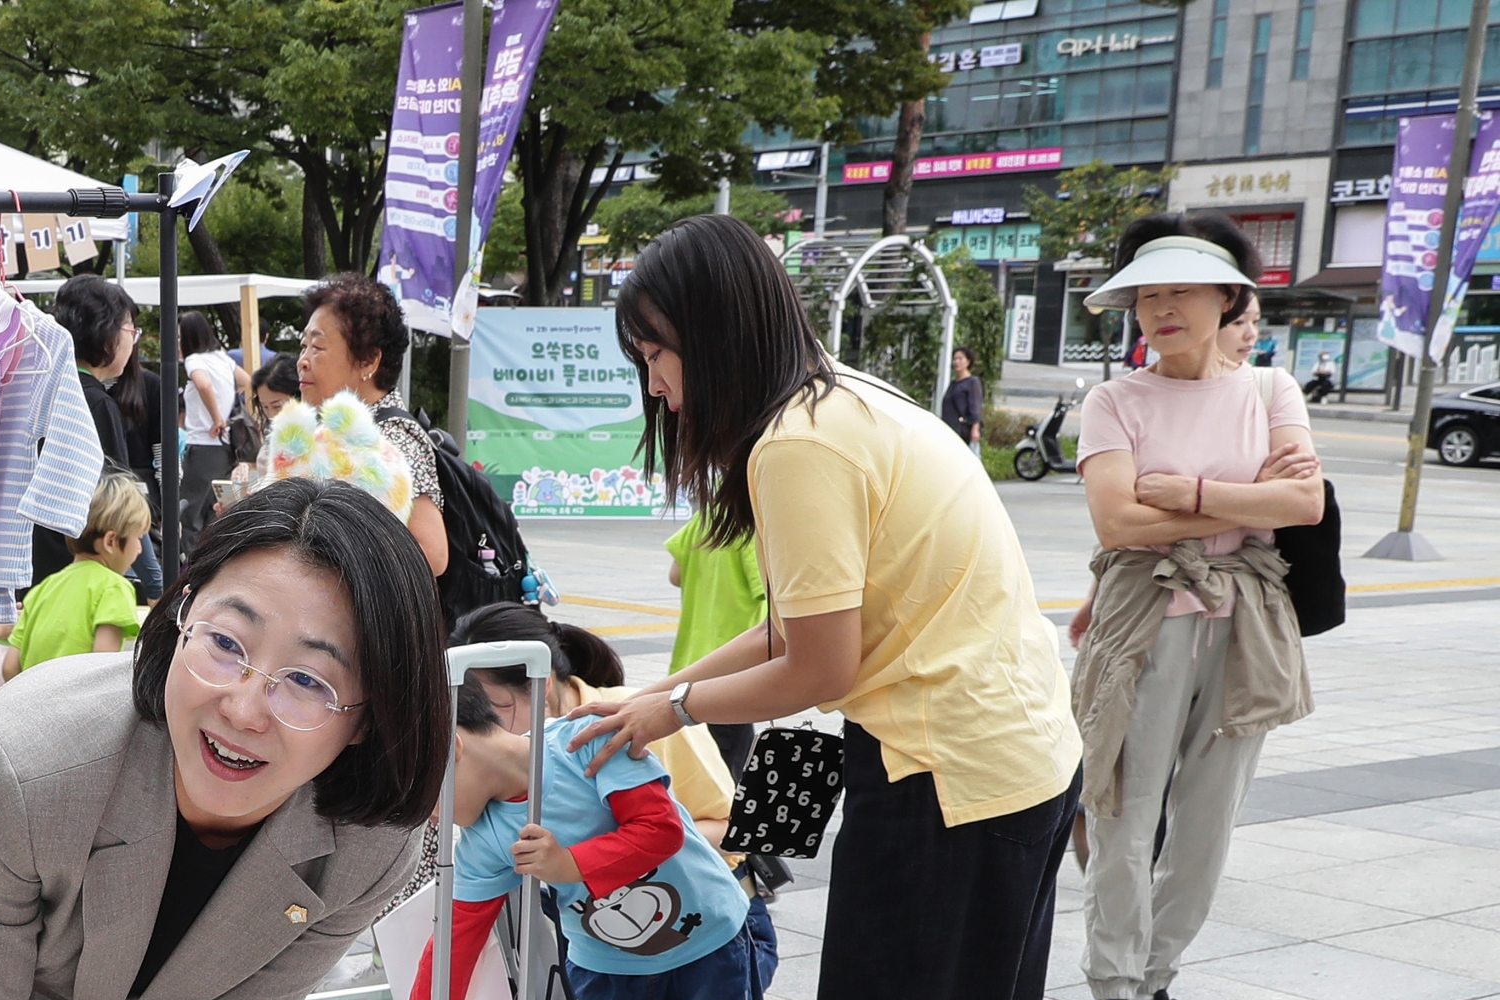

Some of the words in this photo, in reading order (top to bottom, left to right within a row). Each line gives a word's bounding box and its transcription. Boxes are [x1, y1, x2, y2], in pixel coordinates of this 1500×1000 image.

[531, 341, 600, 362] 으쓱ESG
[493, 368, 554, 382] 베이비
[562, 364, 637, 387] 플리마켓
[811, 737, 823, 753] 2
[764, 749, 775, 765] 6
[791, 745, 802, 762] 3
[748, 755, 759, 772] 3
[801, 762, 814, 778] 5
[734, 784, 747, 801] 5
[767, 789, 779, 804] 7
[786, 782, 797, 798] 2
[797, 790, 811, 806] 6
[744, 799, 758, 814] 9
[775, 805, 789, 823] 8
[811, 803, 822, 818] 2
[755, 822, 769, 838] 5
[790, 819, 801, 834] 7
[739, 832, 752, 847] 3
[804, 832, 819, 847] 6
